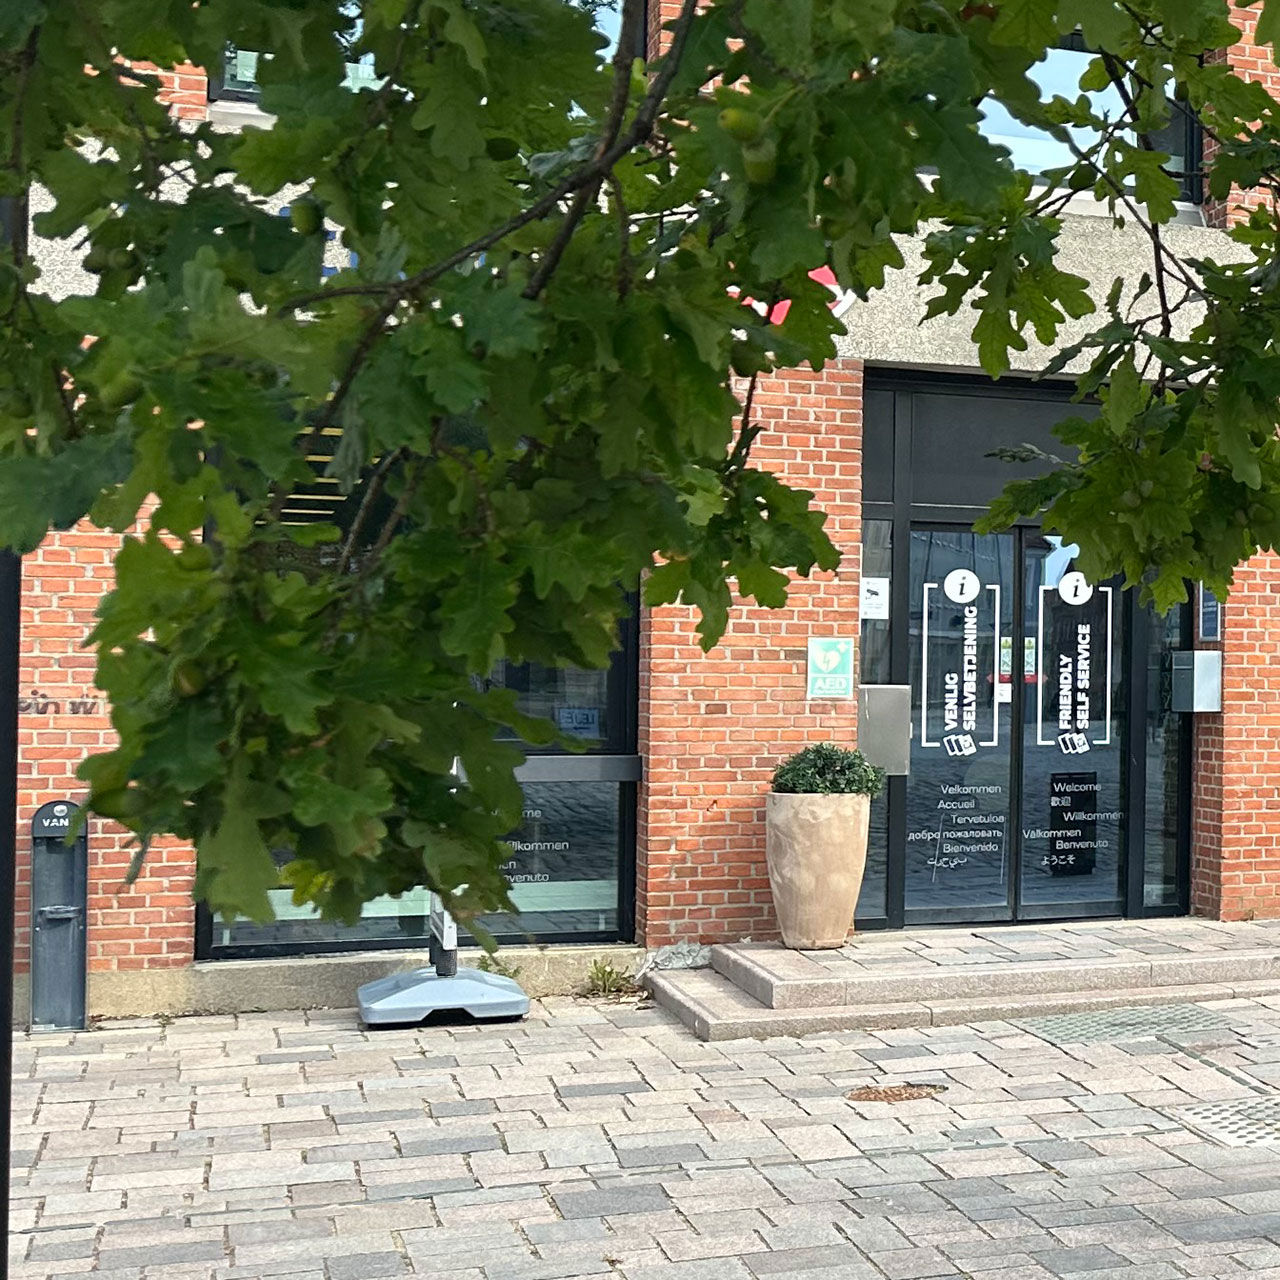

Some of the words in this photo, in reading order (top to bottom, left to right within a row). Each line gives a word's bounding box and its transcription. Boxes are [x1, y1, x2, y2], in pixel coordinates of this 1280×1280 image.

[1077, 623, 1091, 689] SERVICE
[962, 605, 978, 731] SELVBETJENING
[1059, 653, 1073, 730] FRIENDLY
[944, 672, 959, 731] VENLIG
[1076, 690, 1090, 730] SELF
[940, 784, 1002, 794] Velkommen
[1053, 782, 1102, 792] Welcome
[937, 799, 975, 809] Accueil
[950, 813, 1006, 824] Tervetuloa
[1062, 811, 1125, 822] Willkommen
[42, 818, 70, 828] VAN
[907, 829, 941, 841] добро
[942, 829, 1003, 839] пожаловать
[942, 842, 999, 853] Bienvenido
[1055, 840, 1109, 850] Benvenuto
[1041, 854, 1077, 866] ようこそ
